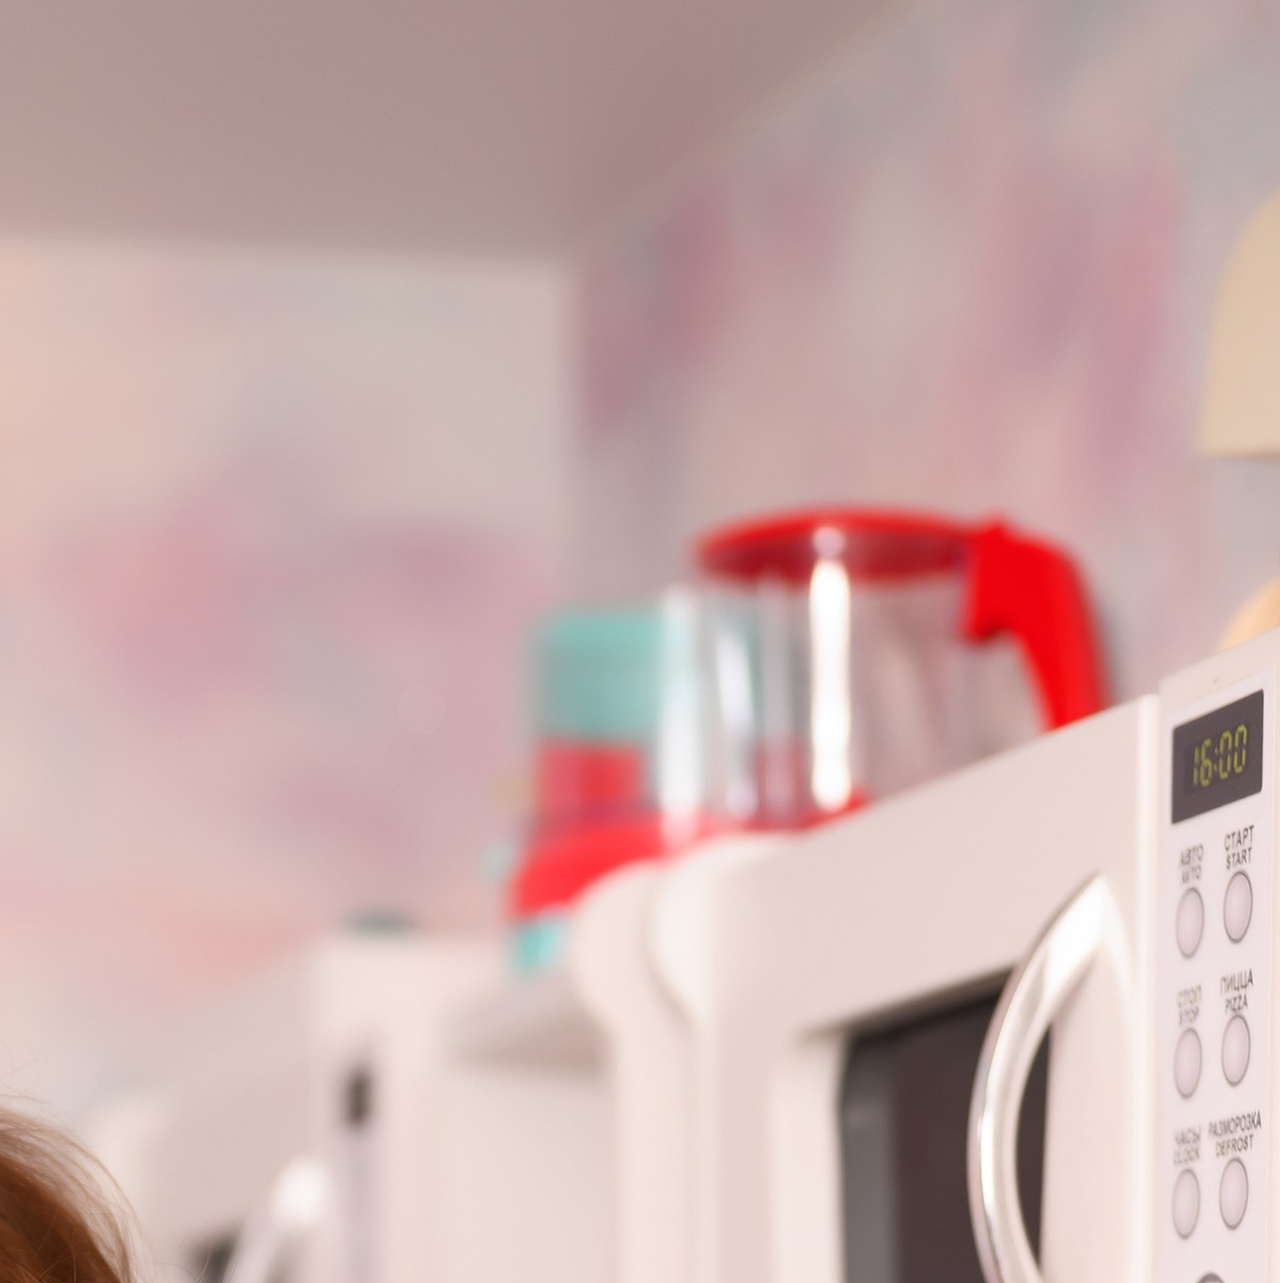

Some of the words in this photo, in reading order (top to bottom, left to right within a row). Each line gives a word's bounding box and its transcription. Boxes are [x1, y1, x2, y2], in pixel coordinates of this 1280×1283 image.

[1193, 724, 1248, 788] 16:00
[1223, 825, 1255, 851] СТАРТ
[1226, 846, 1252, 870] START
[1220, 967, 1254, 996] ПИЦЦА
[1225, 992, 1248, 1014] PIZZA
[1215, 1132, 1253, 1157] DEFROST
